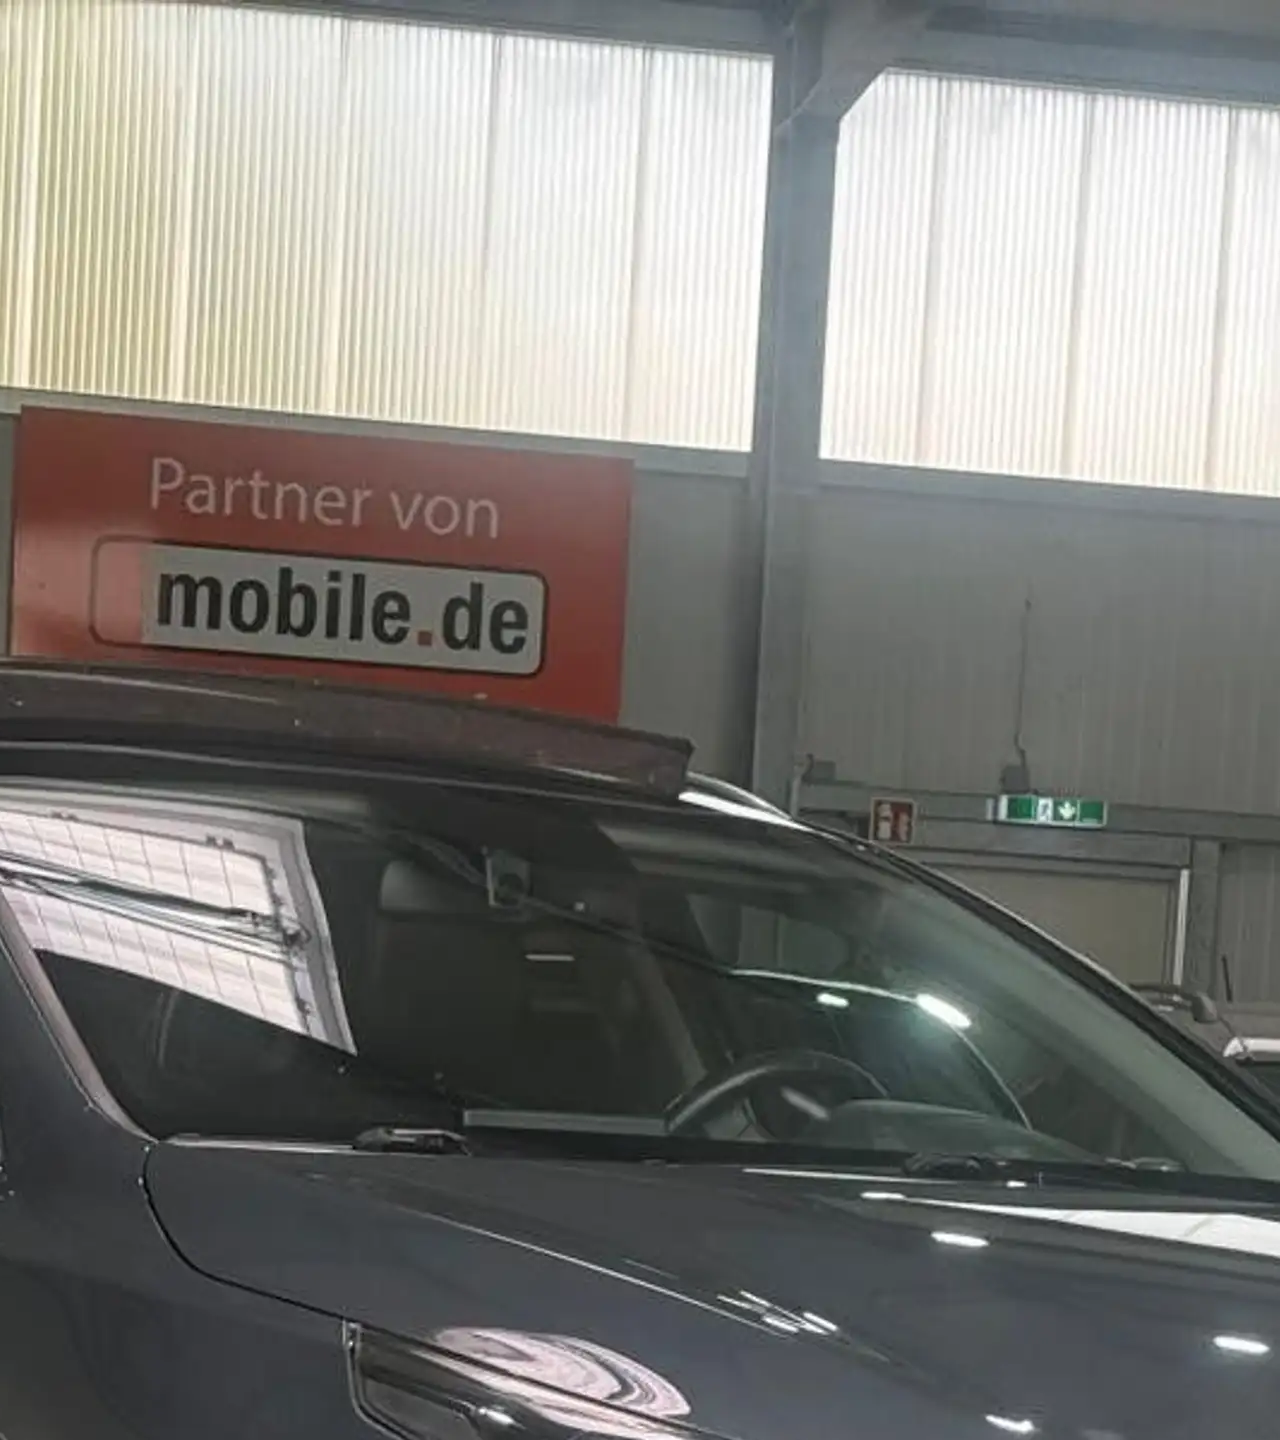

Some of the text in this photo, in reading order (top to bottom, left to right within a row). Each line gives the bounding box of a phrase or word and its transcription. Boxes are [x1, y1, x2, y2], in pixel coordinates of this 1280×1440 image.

[149, 456, 500, 538] Partner von
[156, 565, 530, 654] mobile.de
